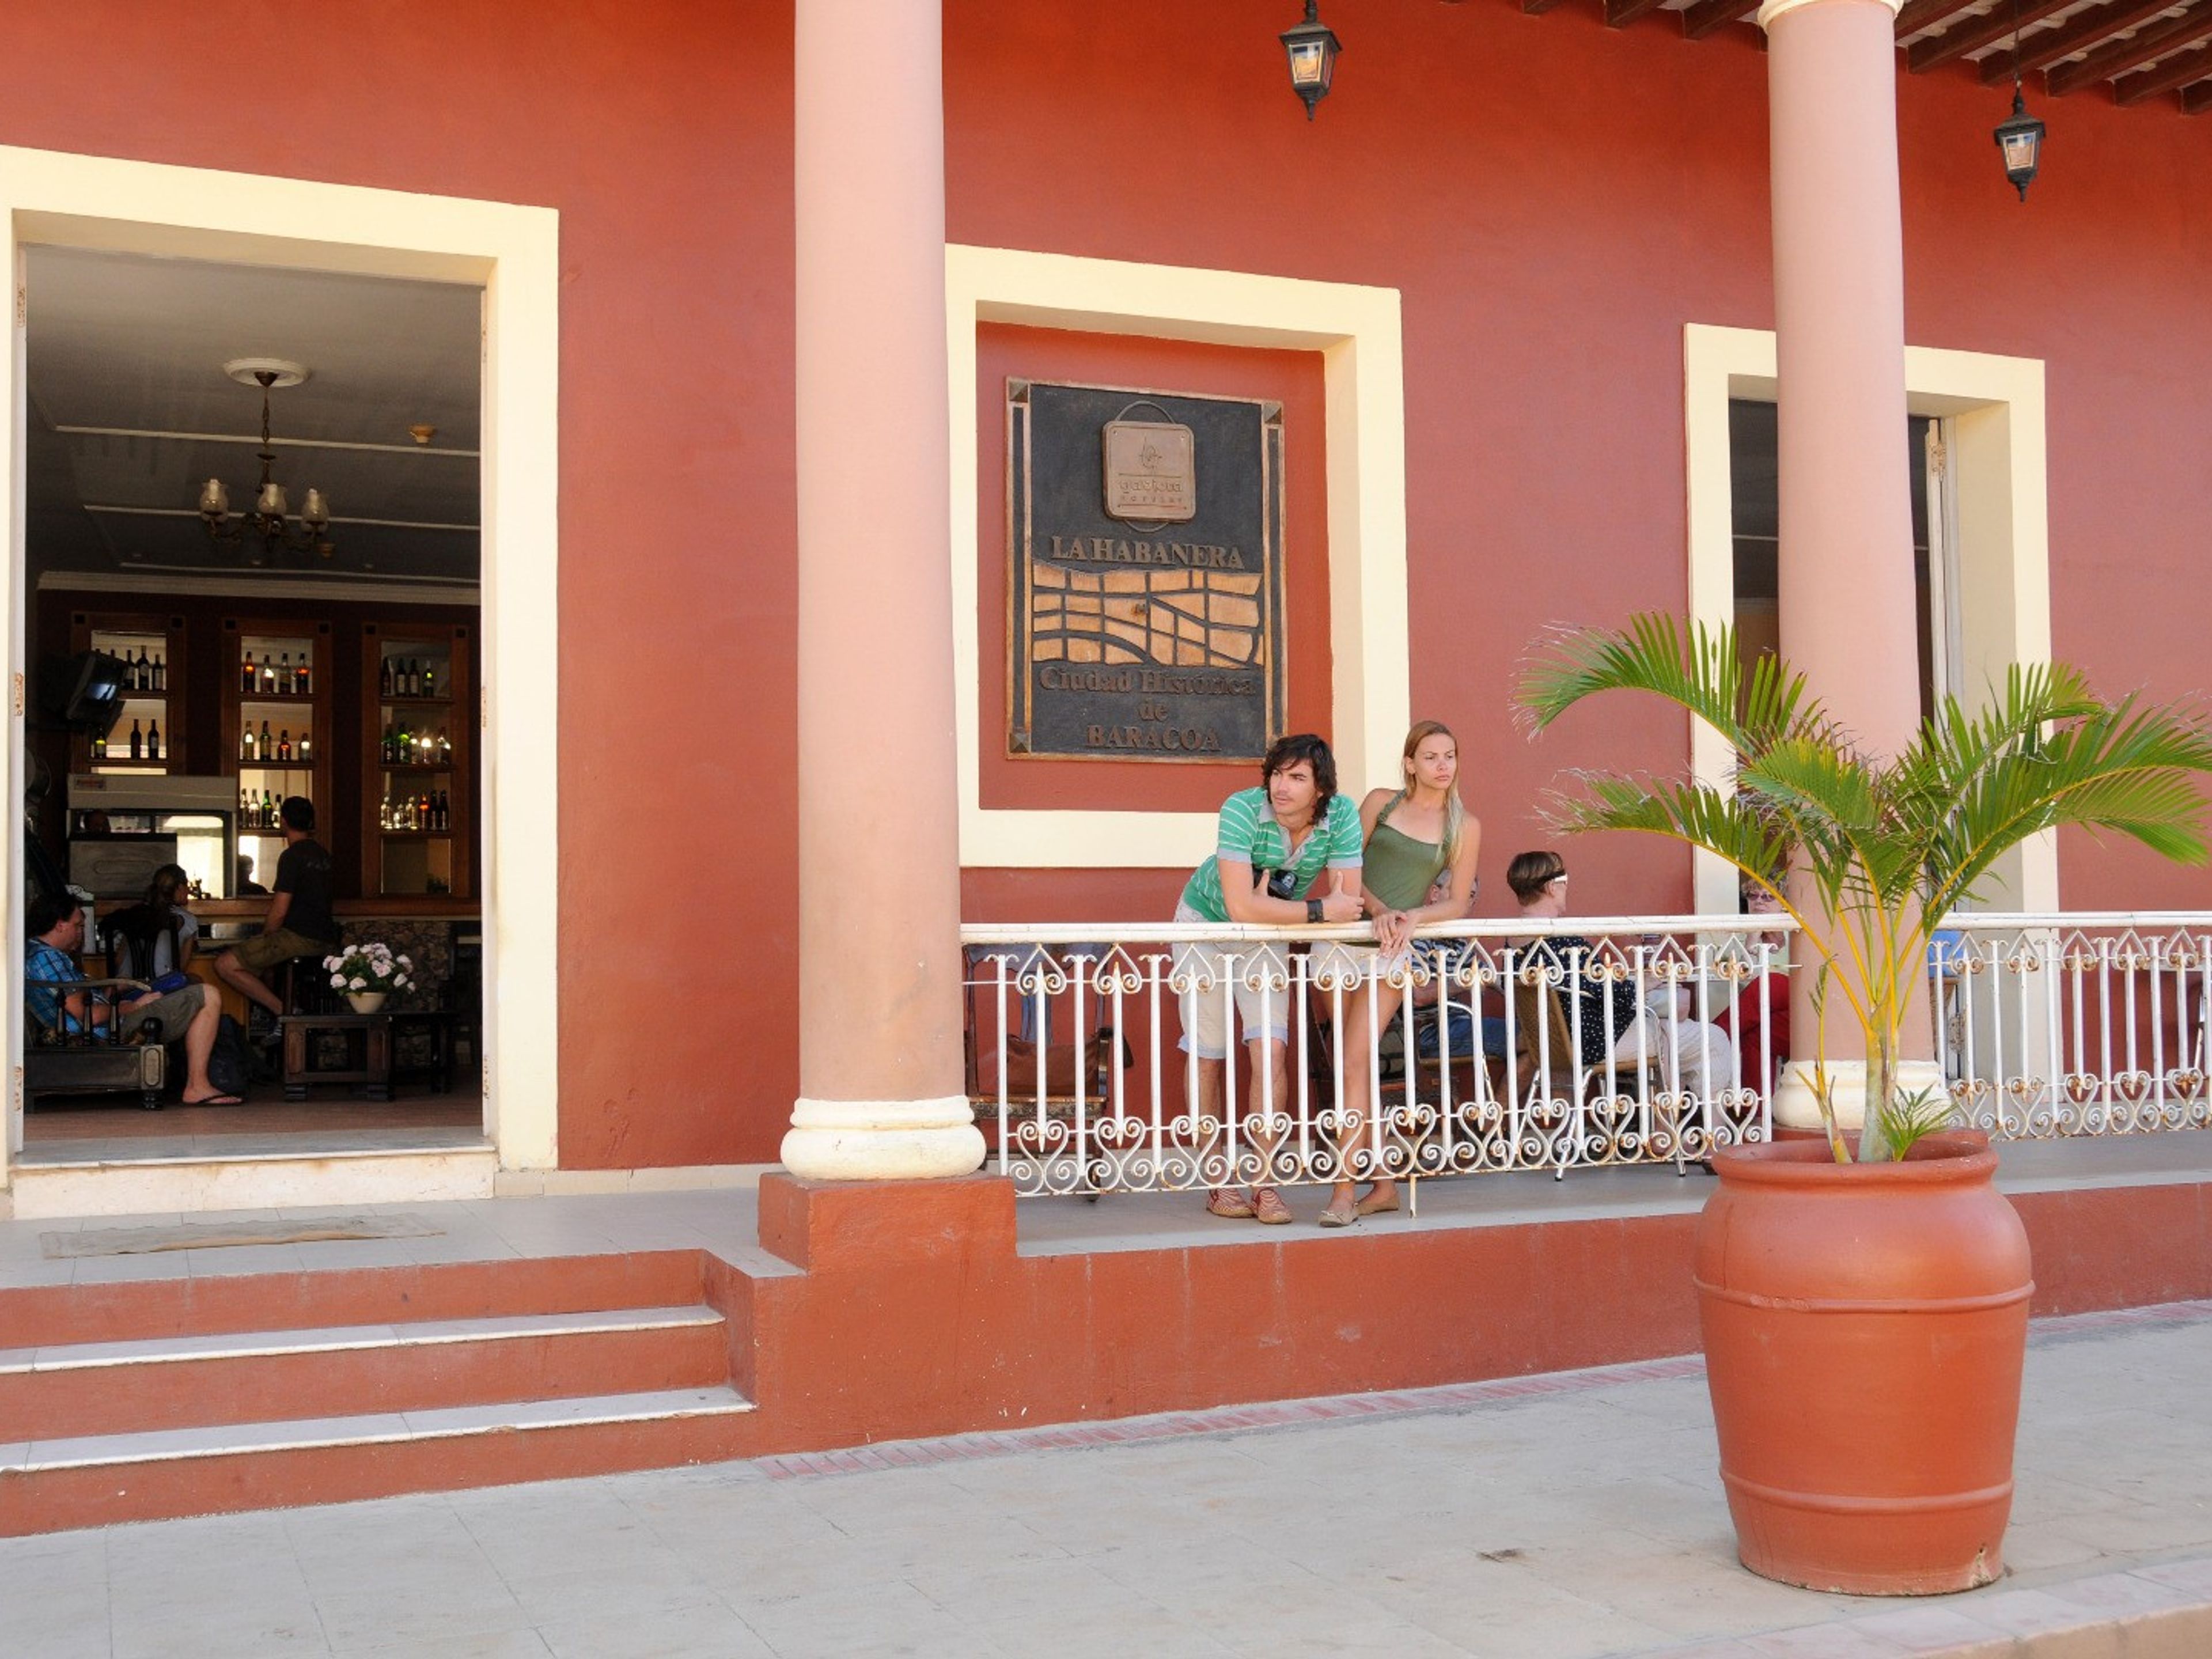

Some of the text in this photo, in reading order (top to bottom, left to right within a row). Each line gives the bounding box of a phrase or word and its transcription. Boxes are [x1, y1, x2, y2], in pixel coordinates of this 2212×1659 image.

[1051, 536, 1245, 569] LA HABANERA
[1039, 666, 1132, 692] Ciudad
[1137, 698, 1169, 721] de
[1087, 725, 1221, 751] BARACOA
